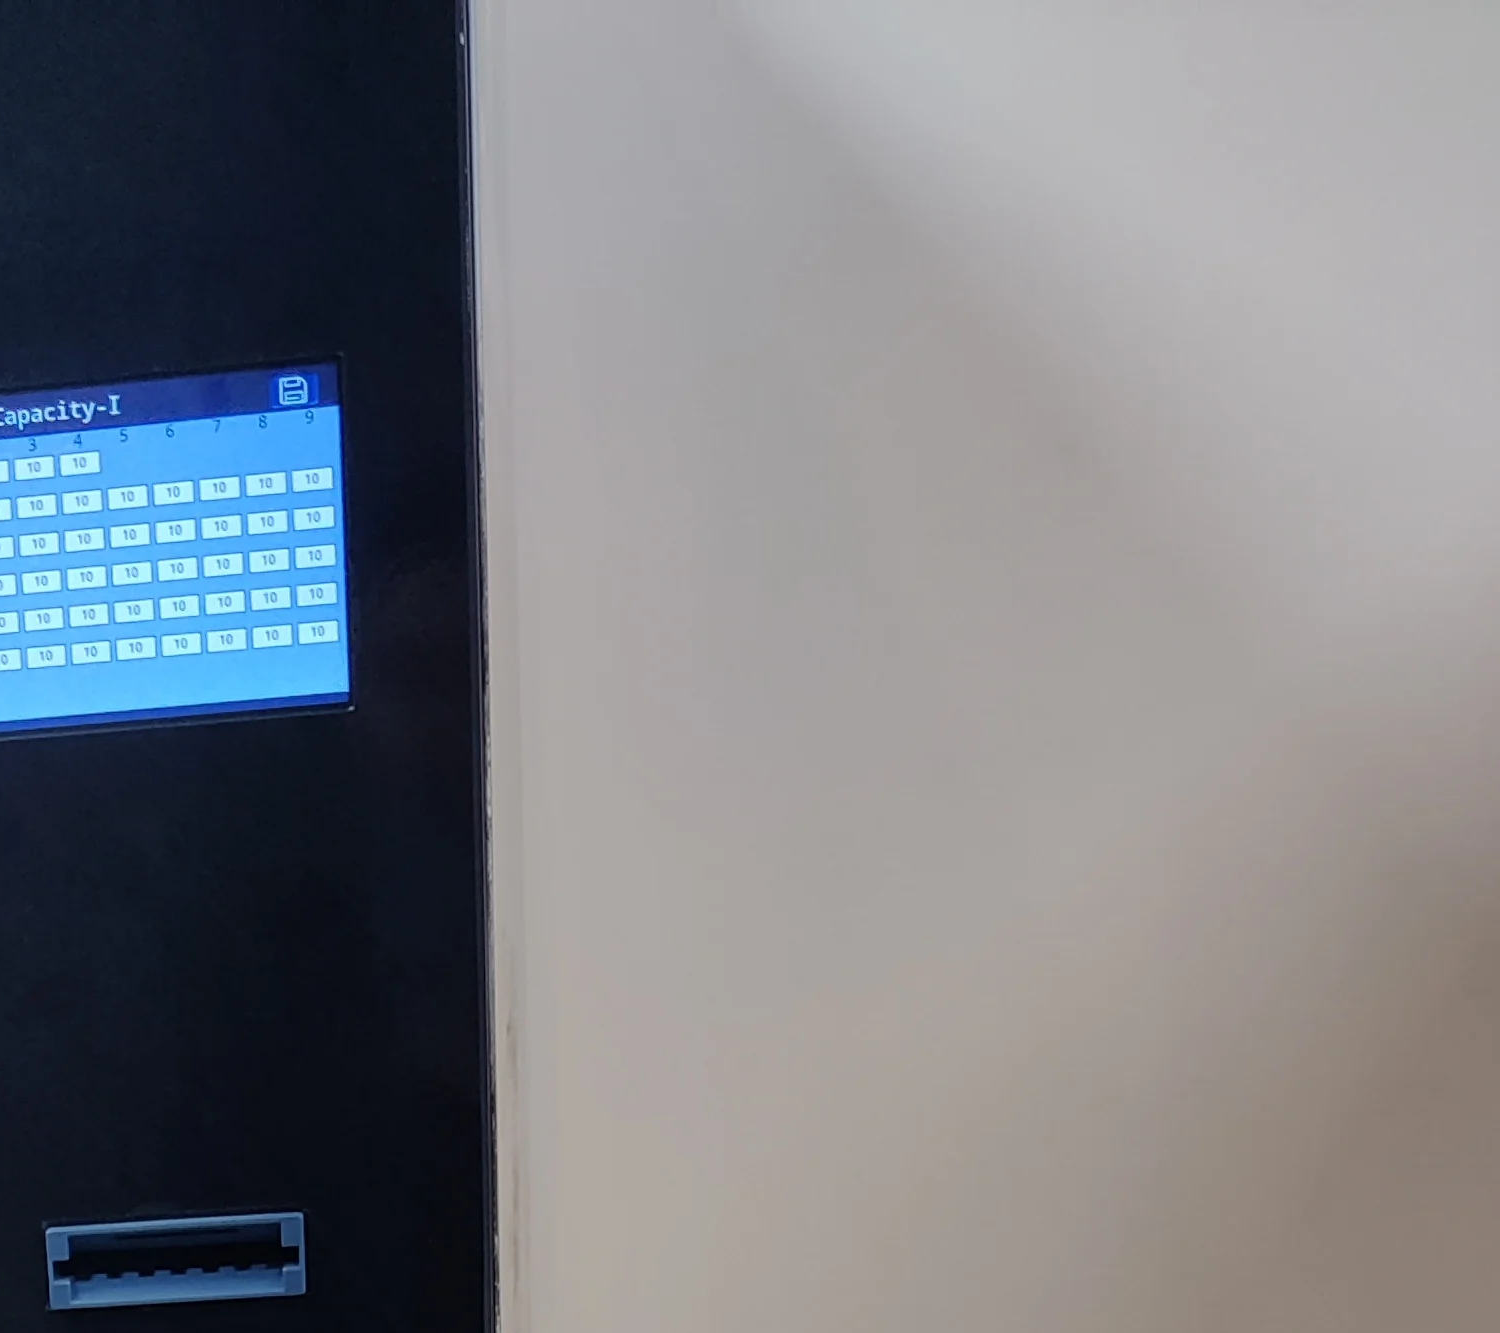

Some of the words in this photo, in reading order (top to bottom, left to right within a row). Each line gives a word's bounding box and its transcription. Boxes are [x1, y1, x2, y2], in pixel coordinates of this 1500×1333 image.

[29, 439, 36, 452] 3
[74, 434, 82, 447] 4
[120, 430, 128, 442] 5
[166, 424, 174, 438] 6
[213, 420, 220, 433] 7
[259, 415, 267, 428] 8
[306, 410, 314, 424] 9
